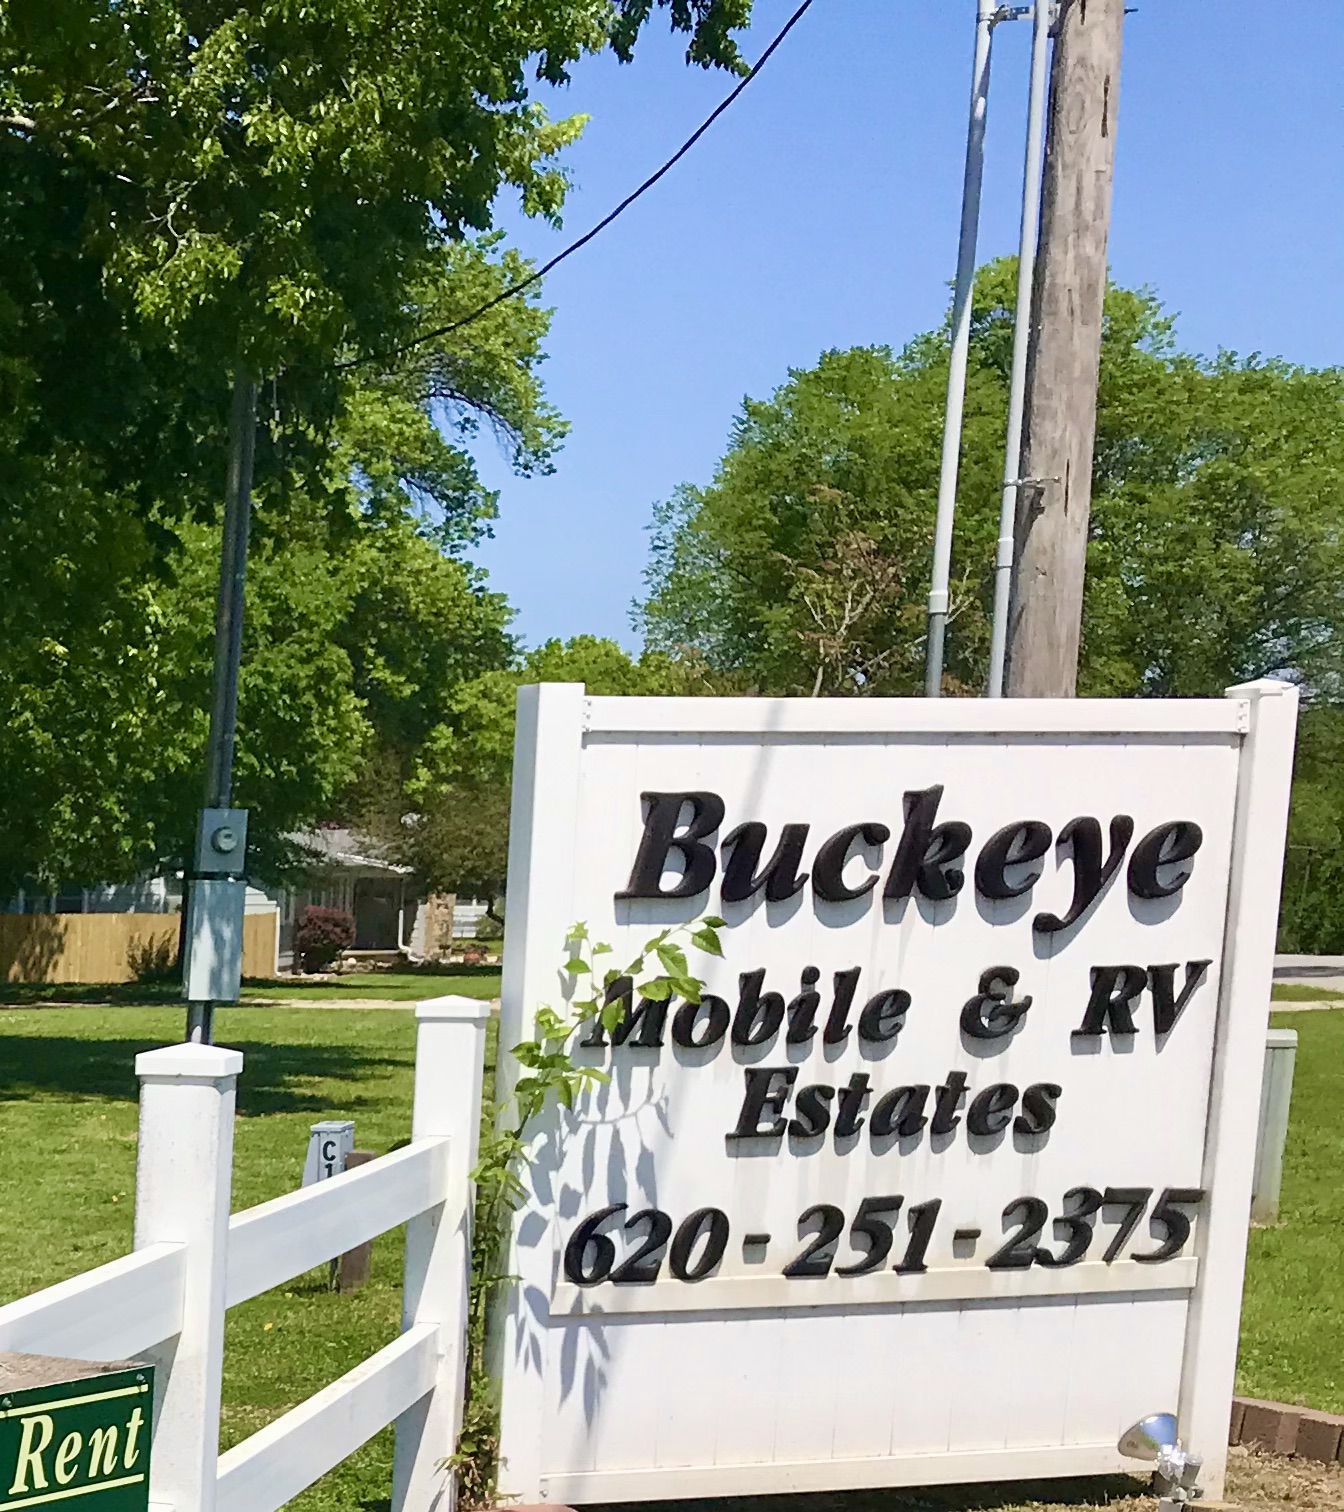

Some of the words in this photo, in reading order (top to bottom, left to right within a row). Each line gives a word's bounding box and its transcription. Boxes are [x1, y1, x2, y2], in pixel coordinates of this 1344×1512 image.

[614, 788, 1203, 940] Buckeye
[580, 967, 912, 1049] Mobile
[960, 966, 1032, 1041] &
[1071, 959, 1213, 1038] RV
[725, 1067, 1062, 1141] Estates
[8, 1407, 145, 1495] Rent
